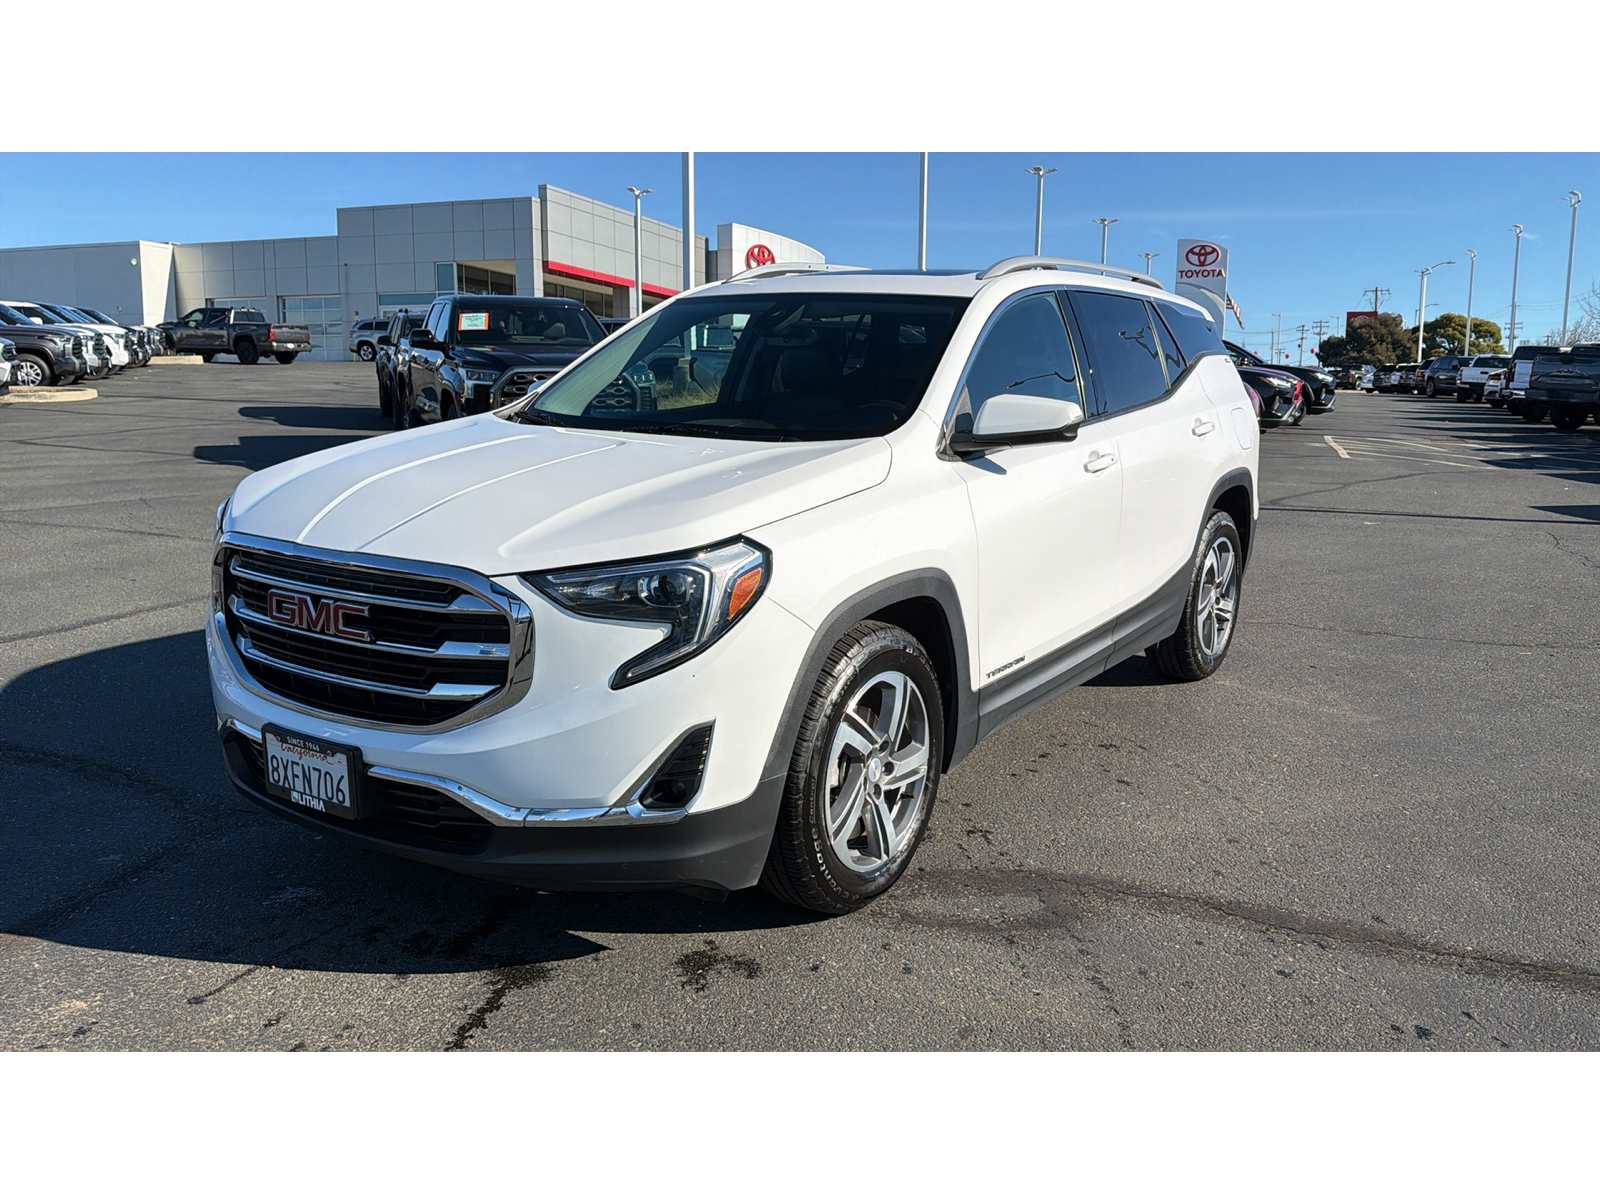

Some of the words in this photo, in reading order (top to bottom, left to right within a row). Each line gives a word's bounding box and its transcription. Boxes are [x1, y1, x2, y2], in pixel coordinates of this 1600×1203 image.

[1178, 268, 1226, 279] TOYOTA
[267, 589, 370, 642] GMC
[985, 655, 1026, 679] TERRAIN
[286, 736, 305, 748] SINCE
[270, 754, 346, 805] 8XFN706
[299, 792, 326, 812] LITHIA
